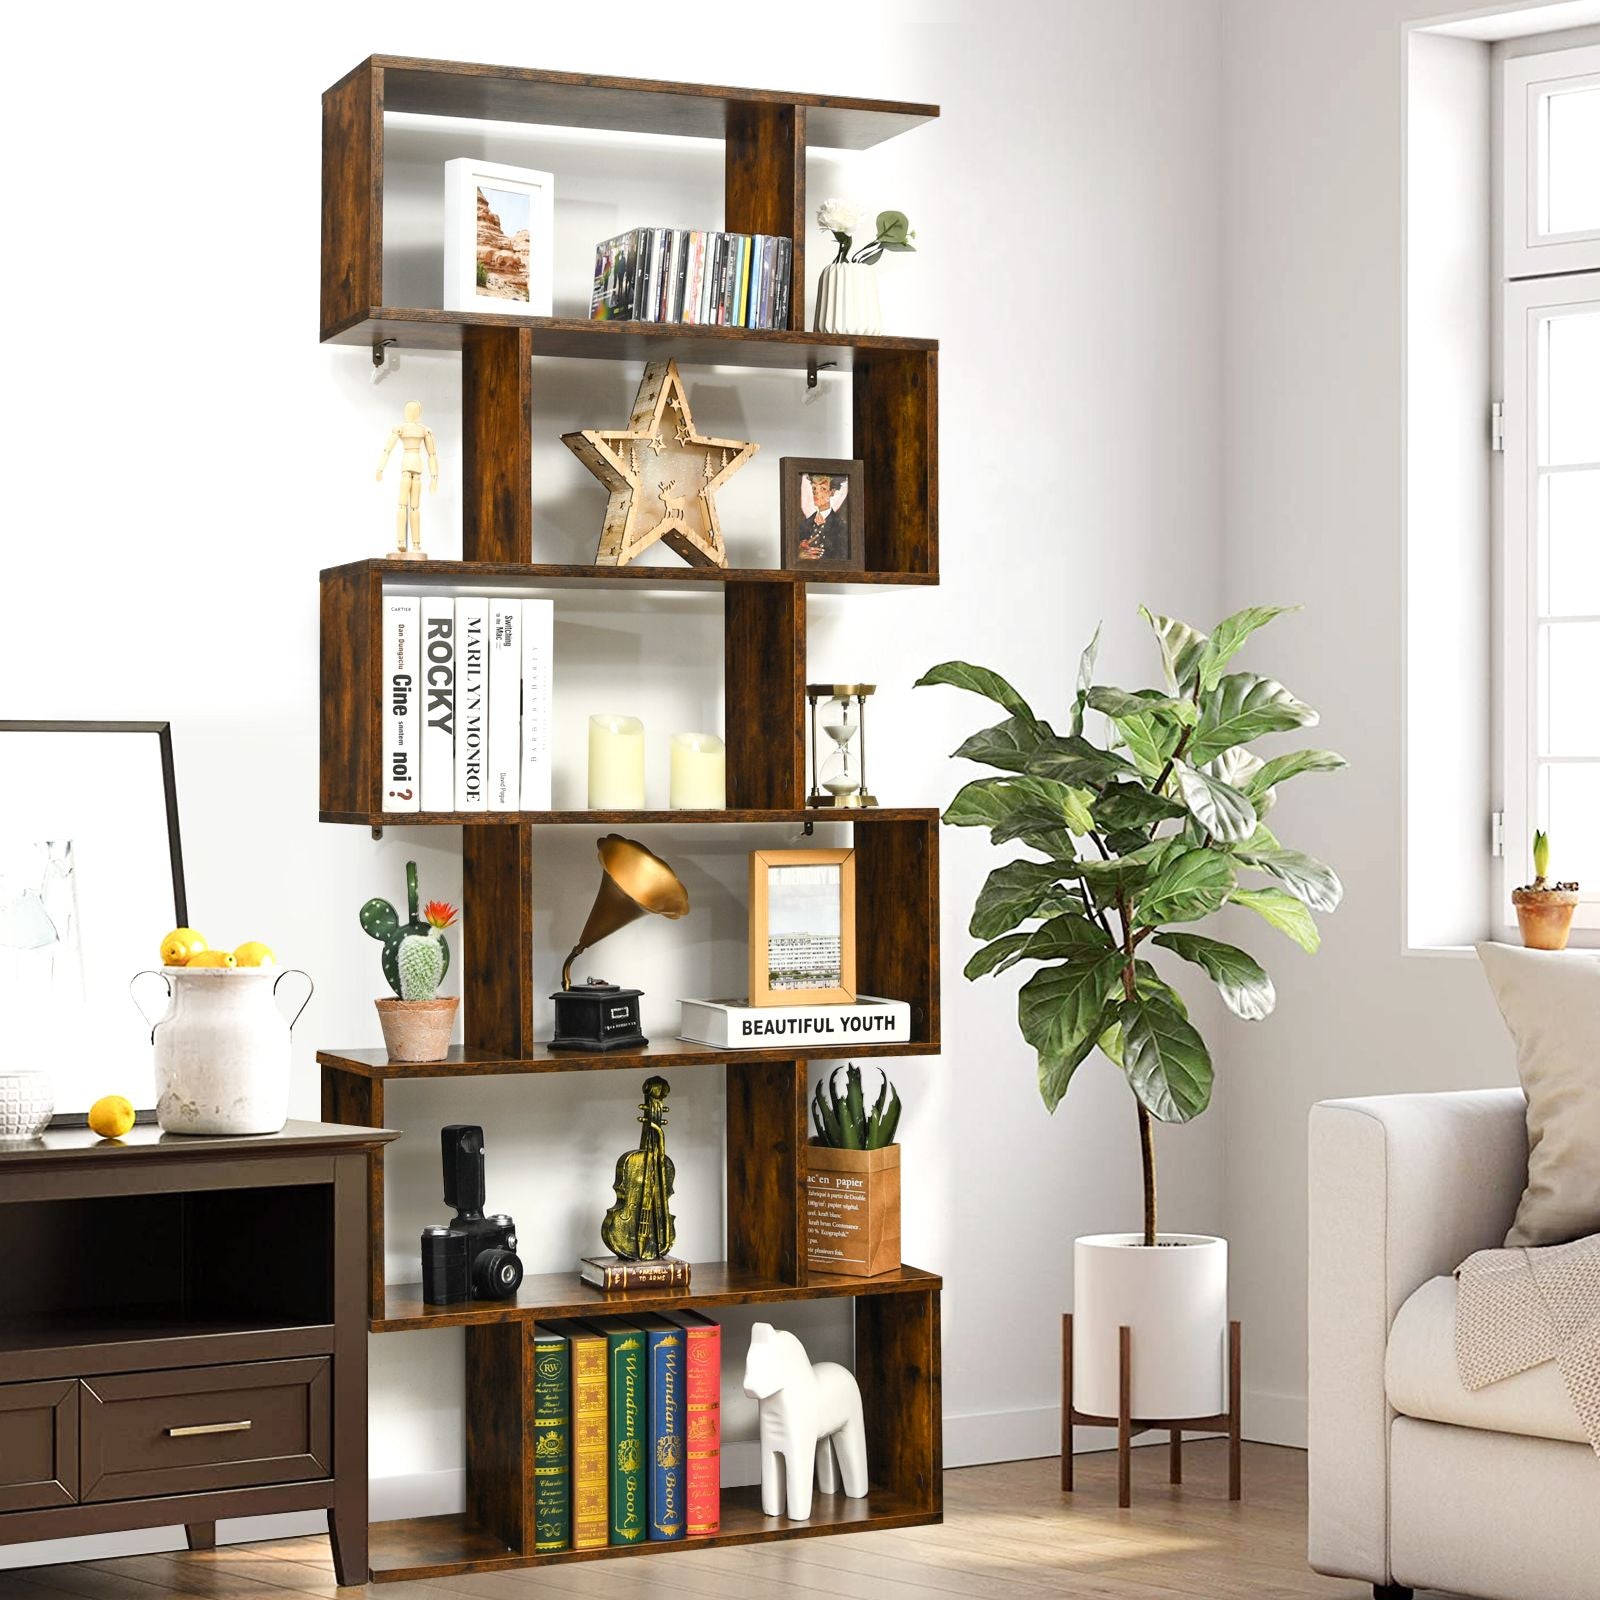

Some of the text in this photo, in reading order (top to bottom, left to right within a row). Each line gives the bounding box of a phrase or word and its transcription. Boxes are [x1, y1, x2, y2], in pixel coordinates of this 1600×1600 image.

[495, 626, 503, 641] Mac
[503, 615, 514, 647] Switching
[393, 674, 412, 717] Cine
[427, 617, 453, 736] ROCKY
[466, 617, 481, 803] MARILYN MONROE
[393, 751, 412, 782] noi
[389, 788, 413, 800] ?
[499, 772, 507, 805] David Pogue
[742, 1015, 895, 1036] BEAUTIFUL YOUTH
[819, 1176, 829, 1184] en
[836, 1177, 863, 1189] papier
[625, 1353, 638, 1438] Wandian
[665, 1350, 679, 1434] Wandian
[624, 1475, 637, 1529] Book
[662, 1471, 678, 1525] Book
